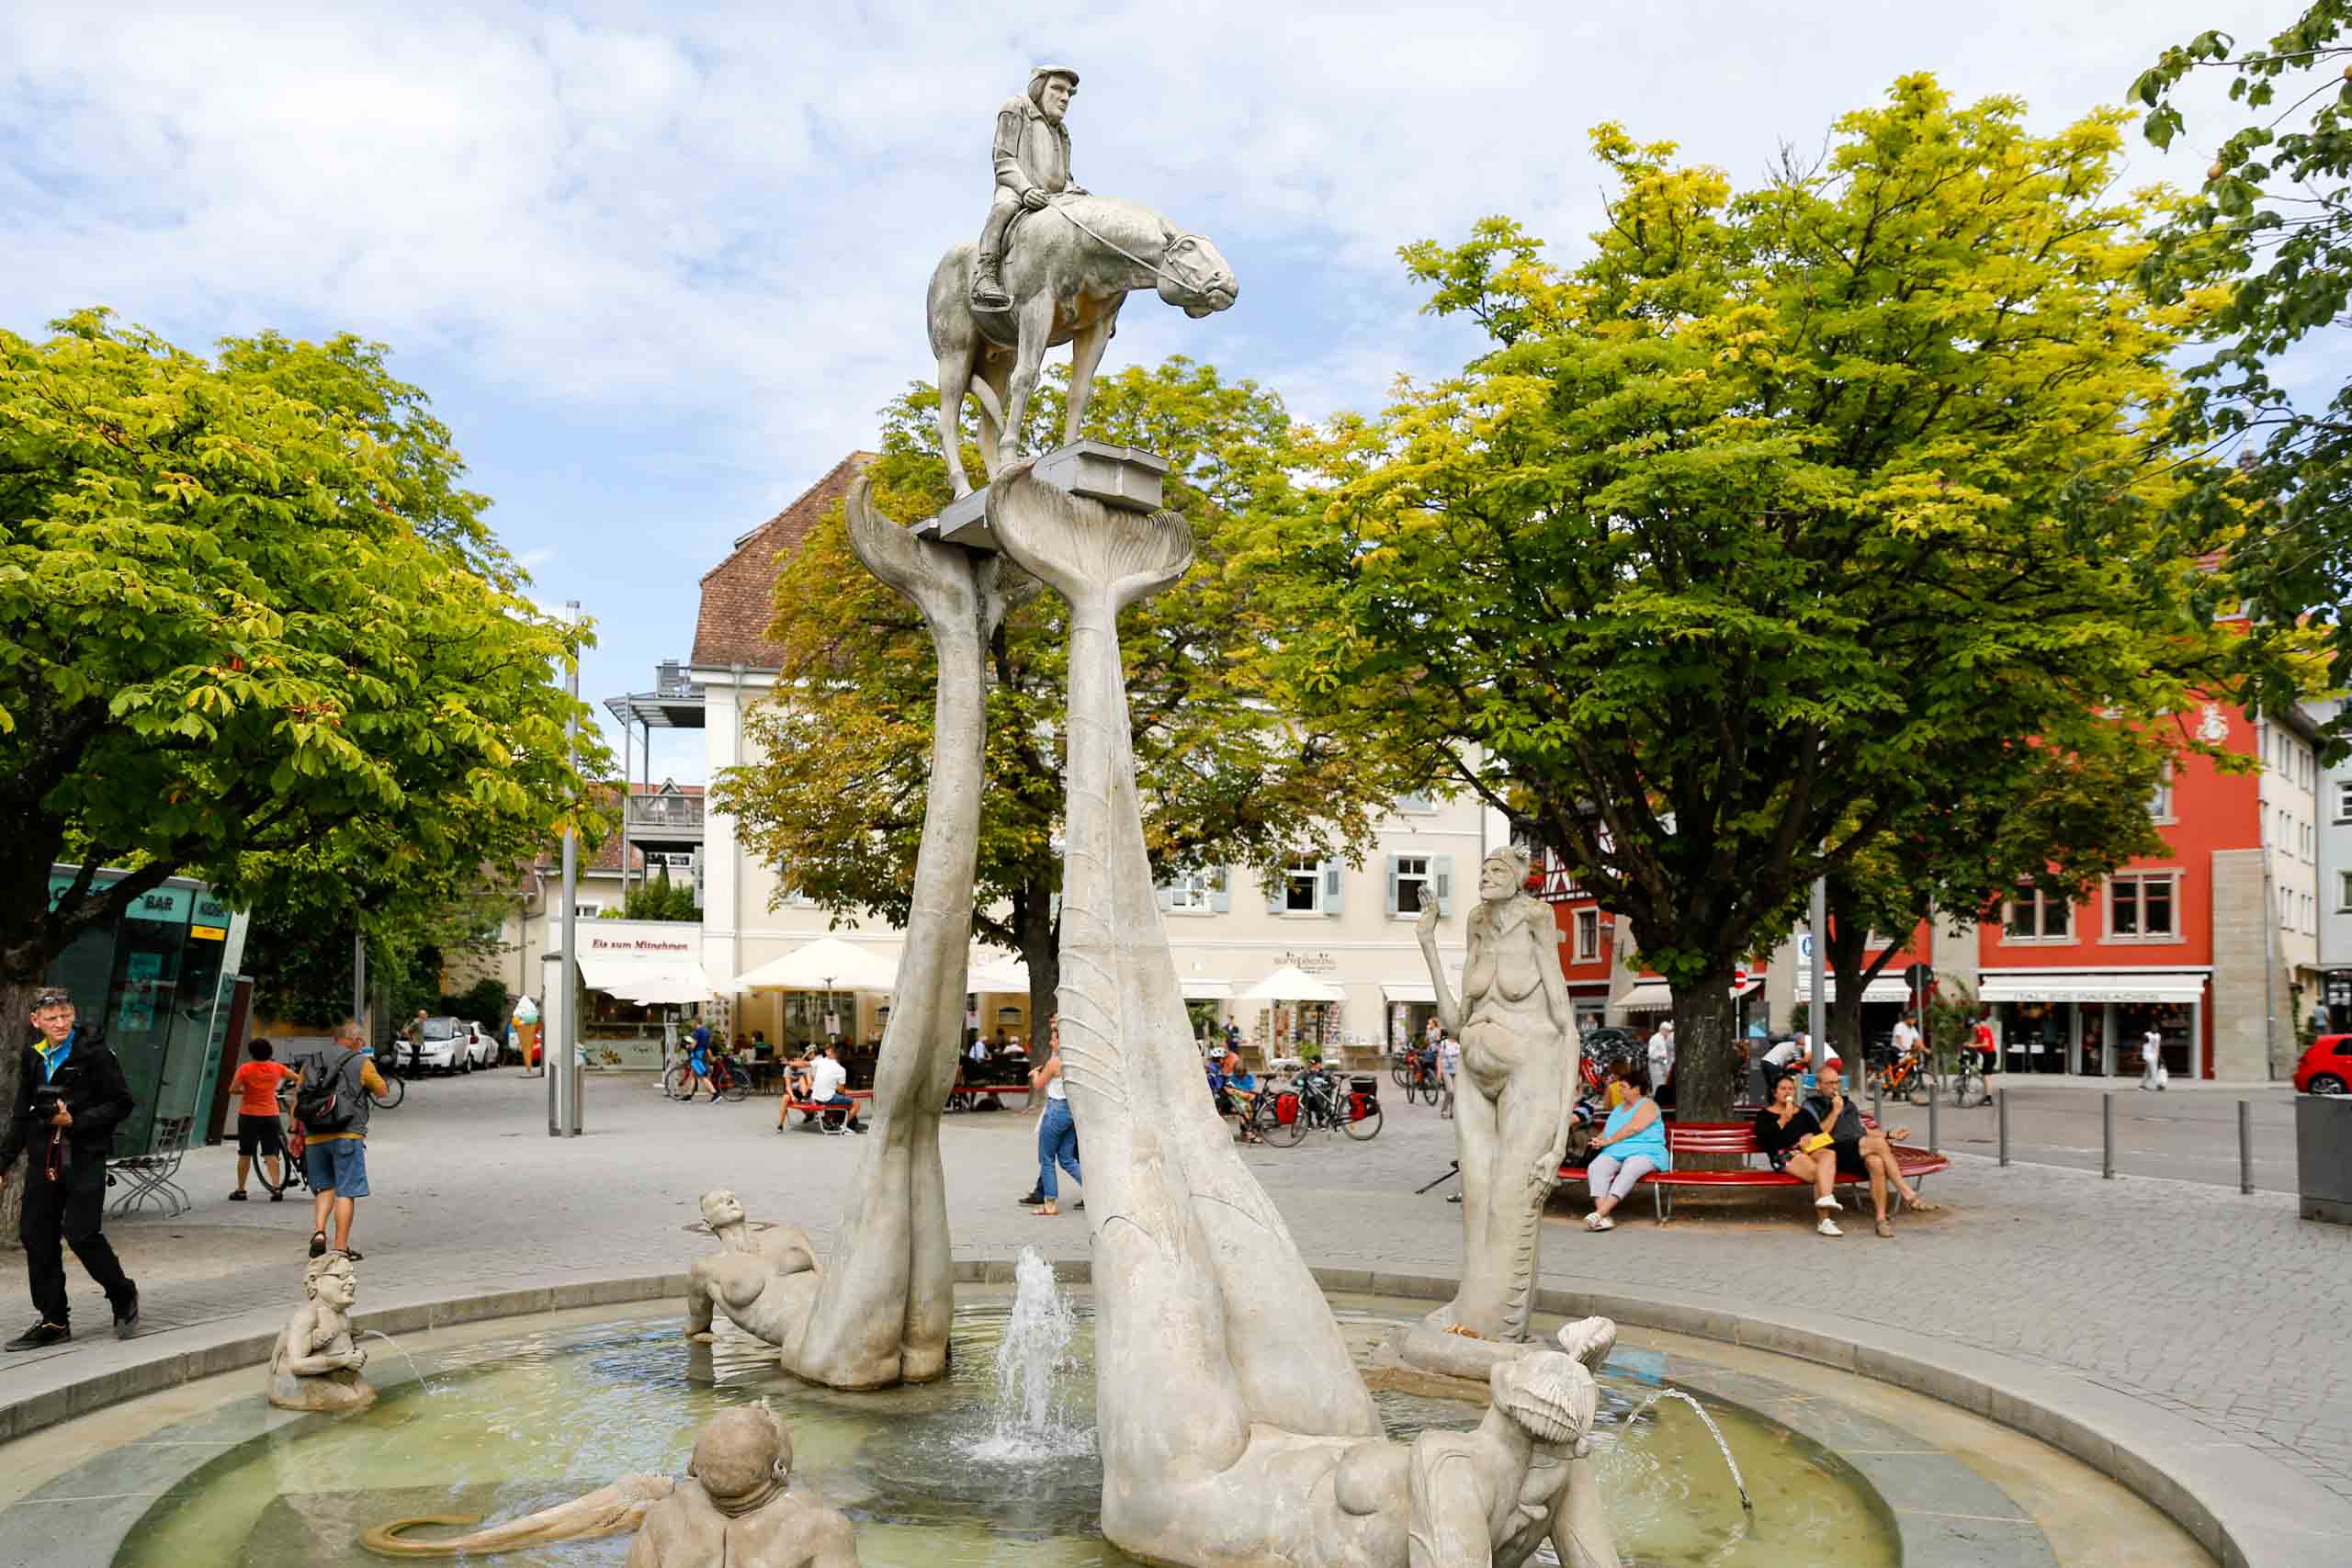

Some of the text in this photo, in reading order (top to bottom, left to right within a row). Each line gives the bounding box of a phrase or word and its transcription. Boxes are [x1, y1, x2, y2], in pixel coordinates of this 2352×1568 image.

[144, 895, 175, 912] BAR
[593, 939, 688, 951] Eis zum Mitnehmen
